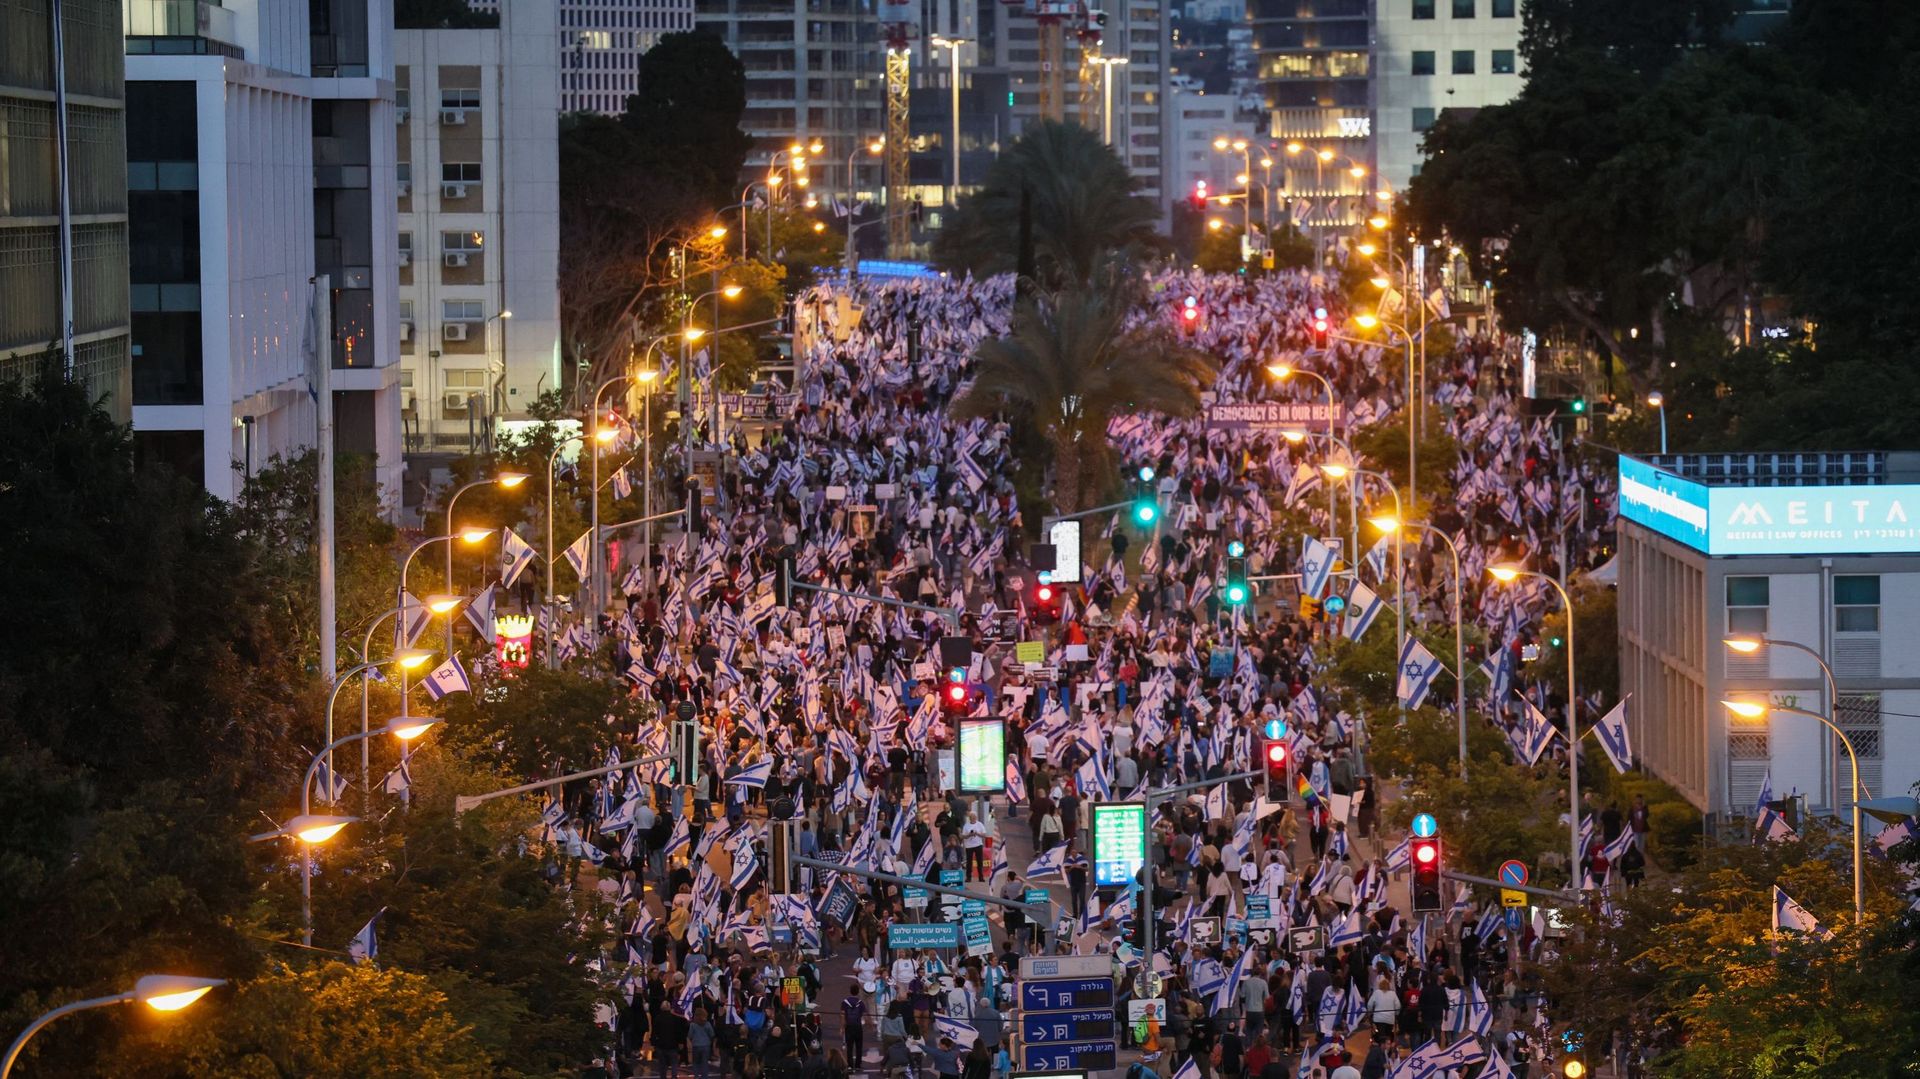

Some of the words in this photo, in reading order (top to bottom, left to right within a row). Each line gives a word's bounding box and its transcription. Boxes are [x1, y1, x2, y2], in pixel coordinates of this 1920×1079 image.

[1212, 406, 1266, 421] DEMOCRACY
[1268, 406, 1278, 421] IS
[1279, 406, 1290, 420] IN
[1291, 405, 1311, 420] OUR
[1775, 531, 1796, 540] LAW
[1800, 530, 1843, 539] OFFICES
[1853, 529, 1871, 540] דין
[890, 936, 914, 946] السلام
[938, 936, 956, 944] نساء
[1080, 982, 1104, 991] גולדה
[1093, 1012, 1112, 1020] מפעל
[1070, 1043, 1093, 1053] לסקוב
[1095, 1044, 1113, 1053] חניון
